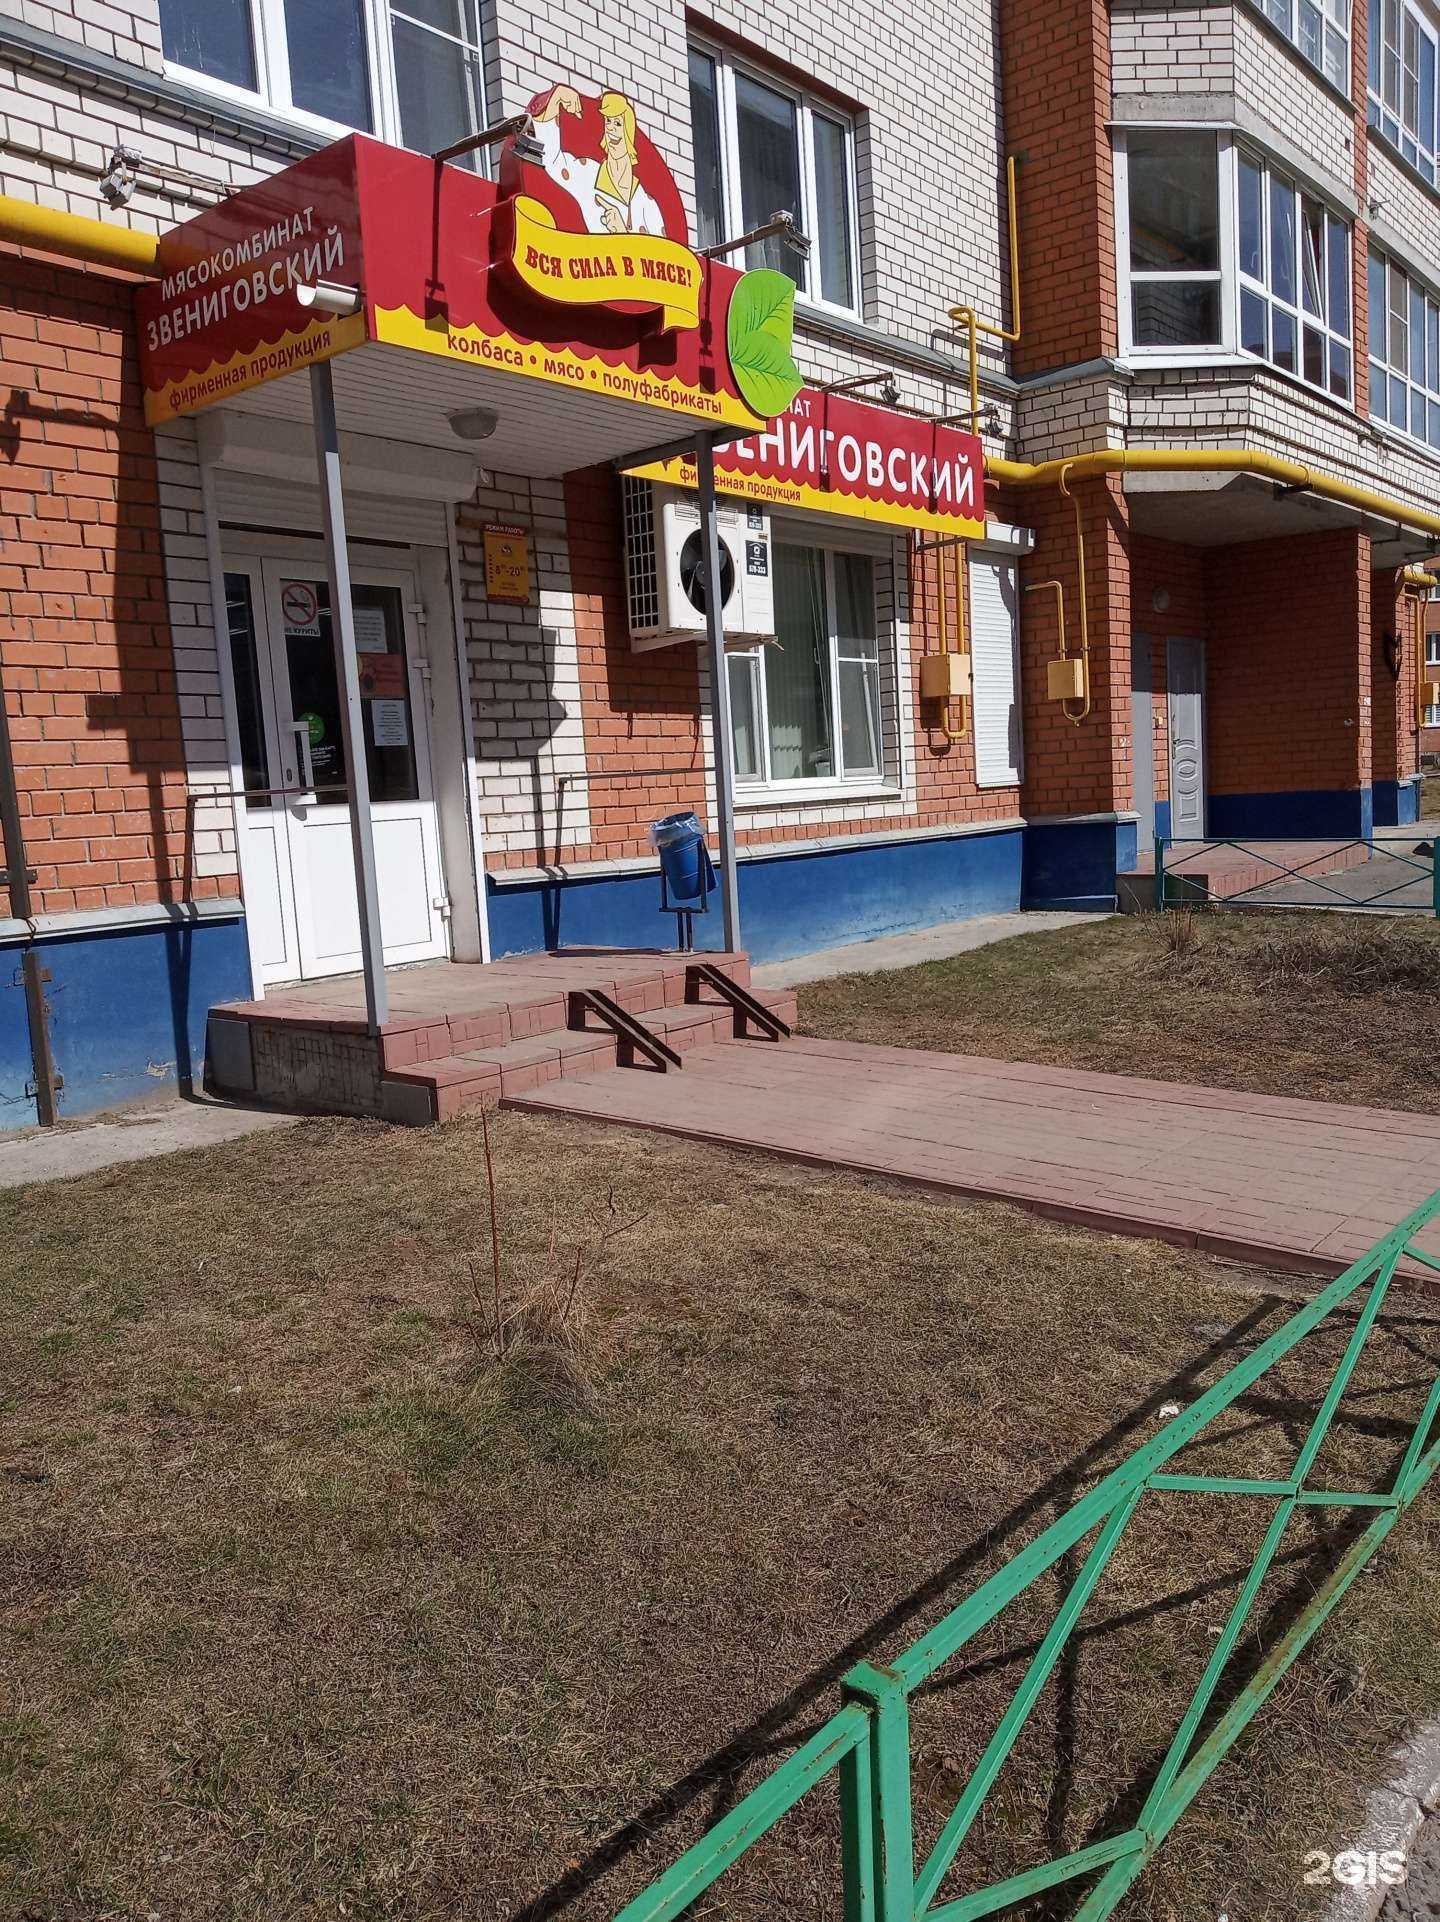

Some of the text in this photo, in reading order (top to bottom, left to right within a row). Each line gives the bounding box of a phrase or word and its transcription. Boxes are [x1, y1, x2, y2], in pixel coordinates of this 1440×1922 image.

[146, 224, 344, 352] ЗВЕНИГОВСКИЙ
[161, 206, 314, 302] МЯСОКОМБИНАТ
[525, 245, 693, 289] ВСЯ СИЛА В МЯСЕ!
[169, 329, 331, 412] фирменная продукция
[447, 333, 723, 415] колбаса мясо полуфабрикаты
[679, 465, 801, 502] фиенная продукция
